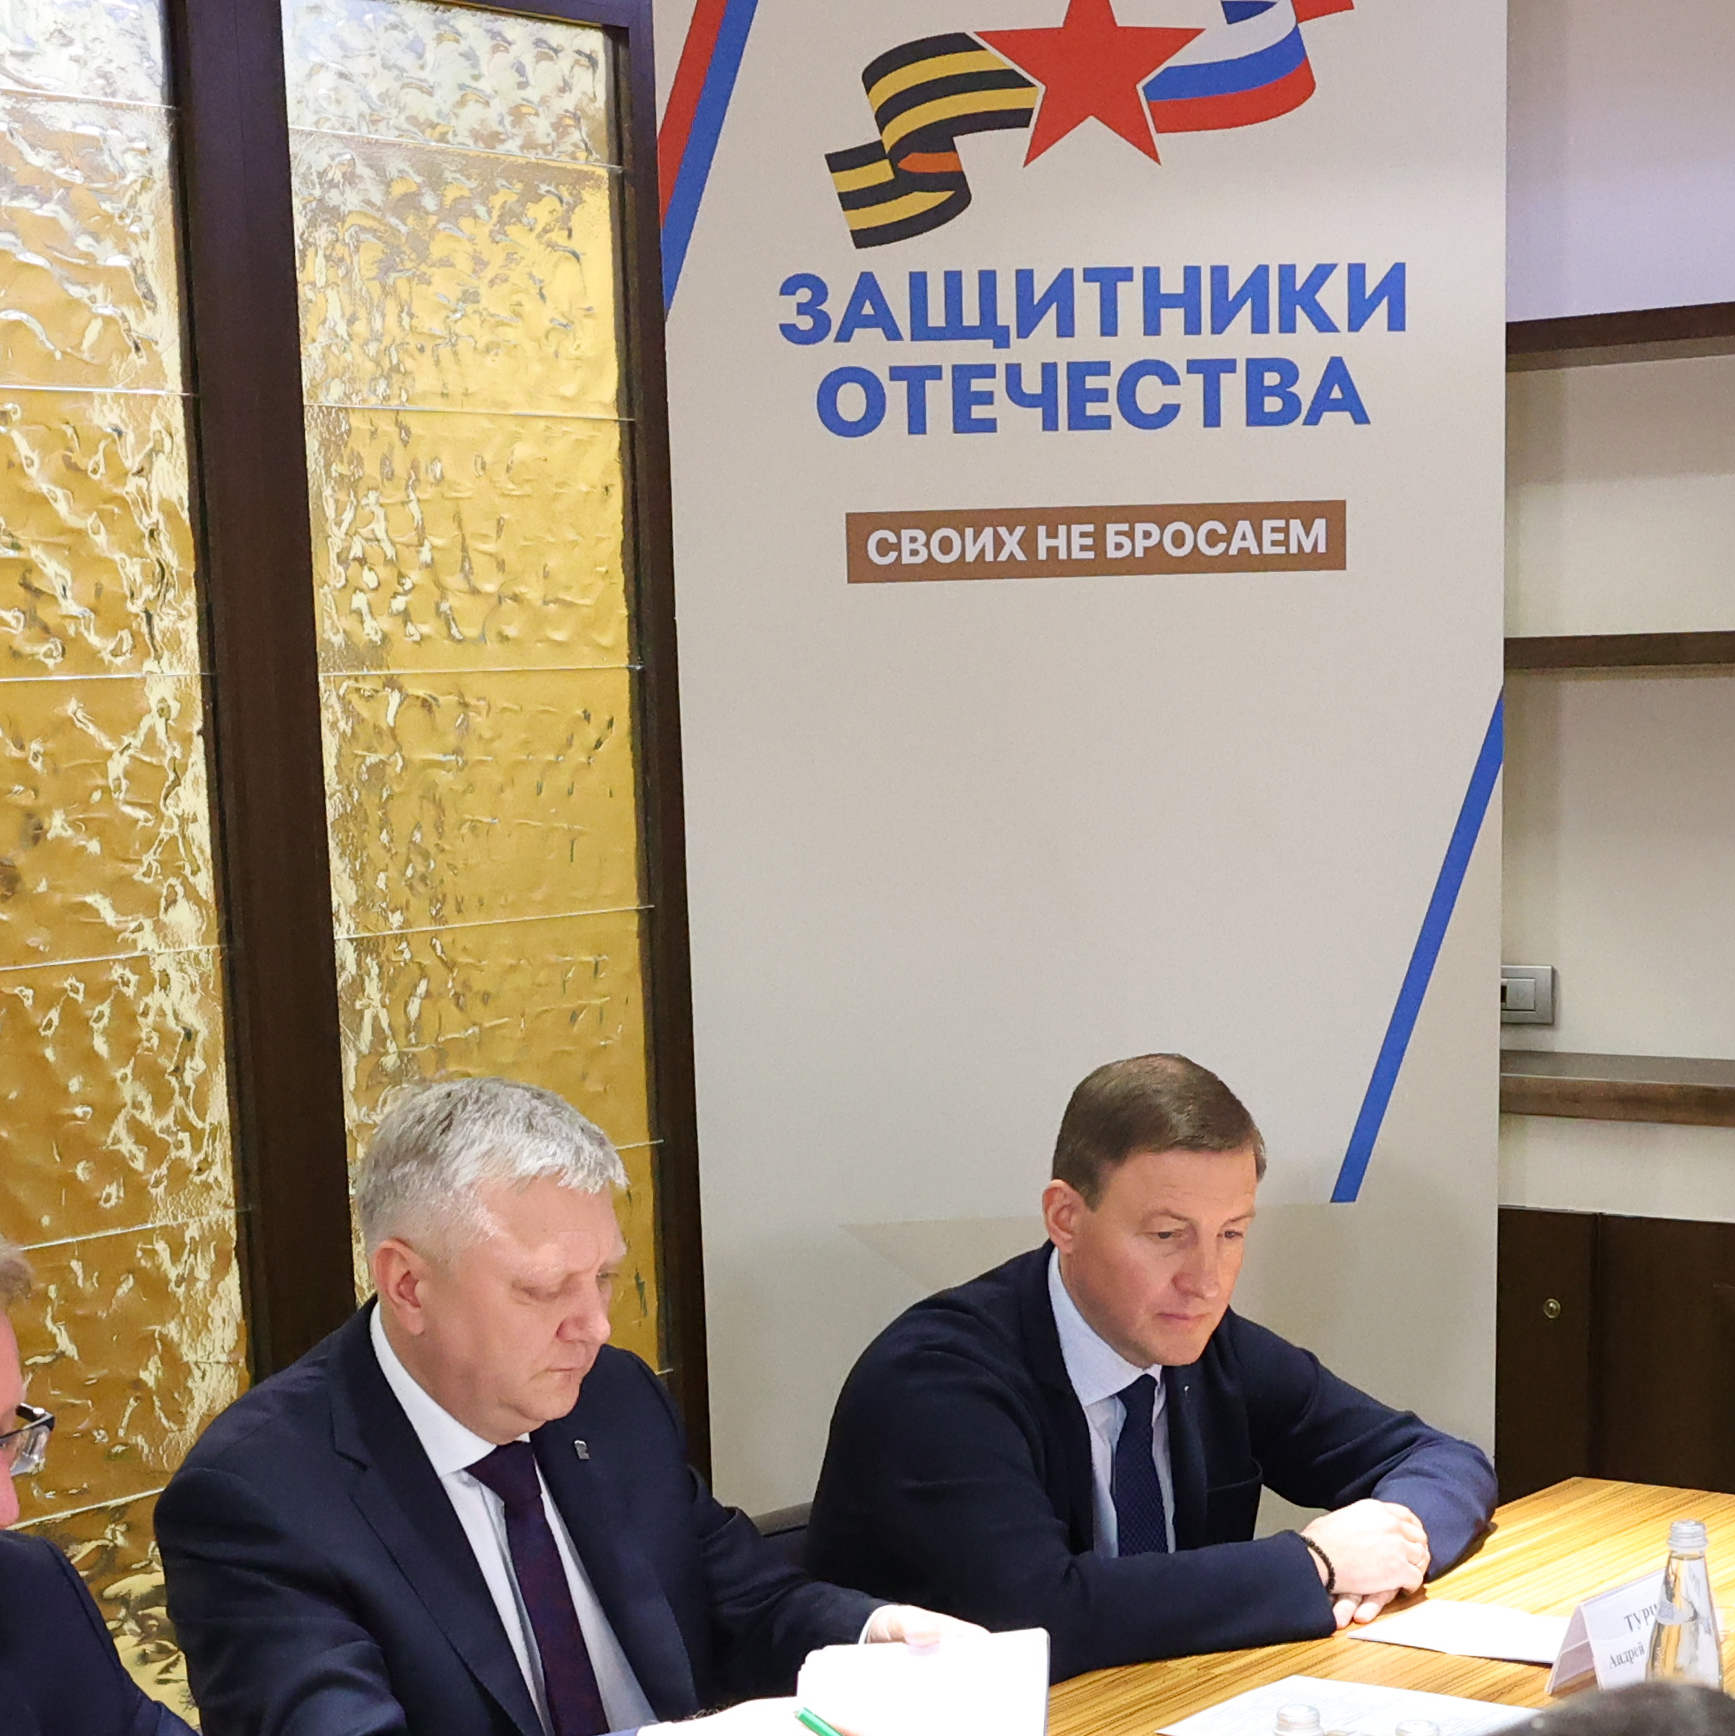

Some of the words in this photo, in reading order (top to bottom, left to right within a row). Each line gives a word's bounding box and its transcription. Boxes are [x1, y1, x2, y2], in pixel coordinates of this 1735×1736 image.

[777, 261, 1408, 349] ЗАЩИТНИКИ
[816, 356, 1371, 438] ОТЕЧЕСТВА
[866, 524, 1027, 566] СВОИХ
[1037, 523, 1096, 562] НЕ
[1105, 518, 1328, 560] БРОСАЕМ
[1609, 1641, 1646, 1669] Андрей
